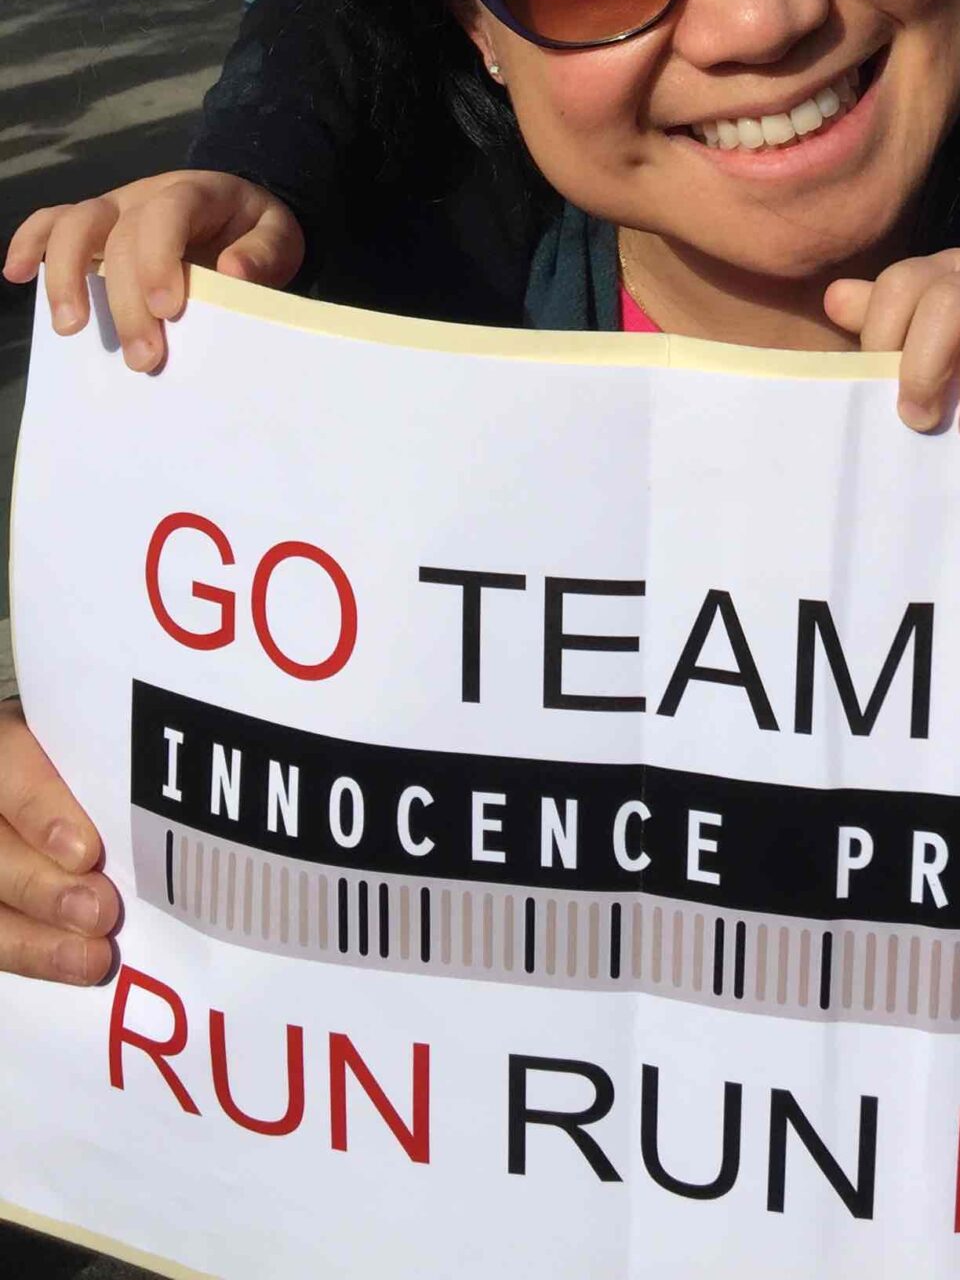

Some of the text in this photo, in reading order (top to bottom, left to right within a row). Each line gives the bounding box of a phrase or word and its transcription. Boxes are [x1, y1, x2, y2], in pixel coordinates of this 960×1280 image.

[145, 511, 358, 681] GO
[419, 566, 935, 739] TEAM
[162, 726, 722, 885] INNOCENCE
[109, 963, 431, 1166] RUN
[508, 1053, 878, 1220] RUN
